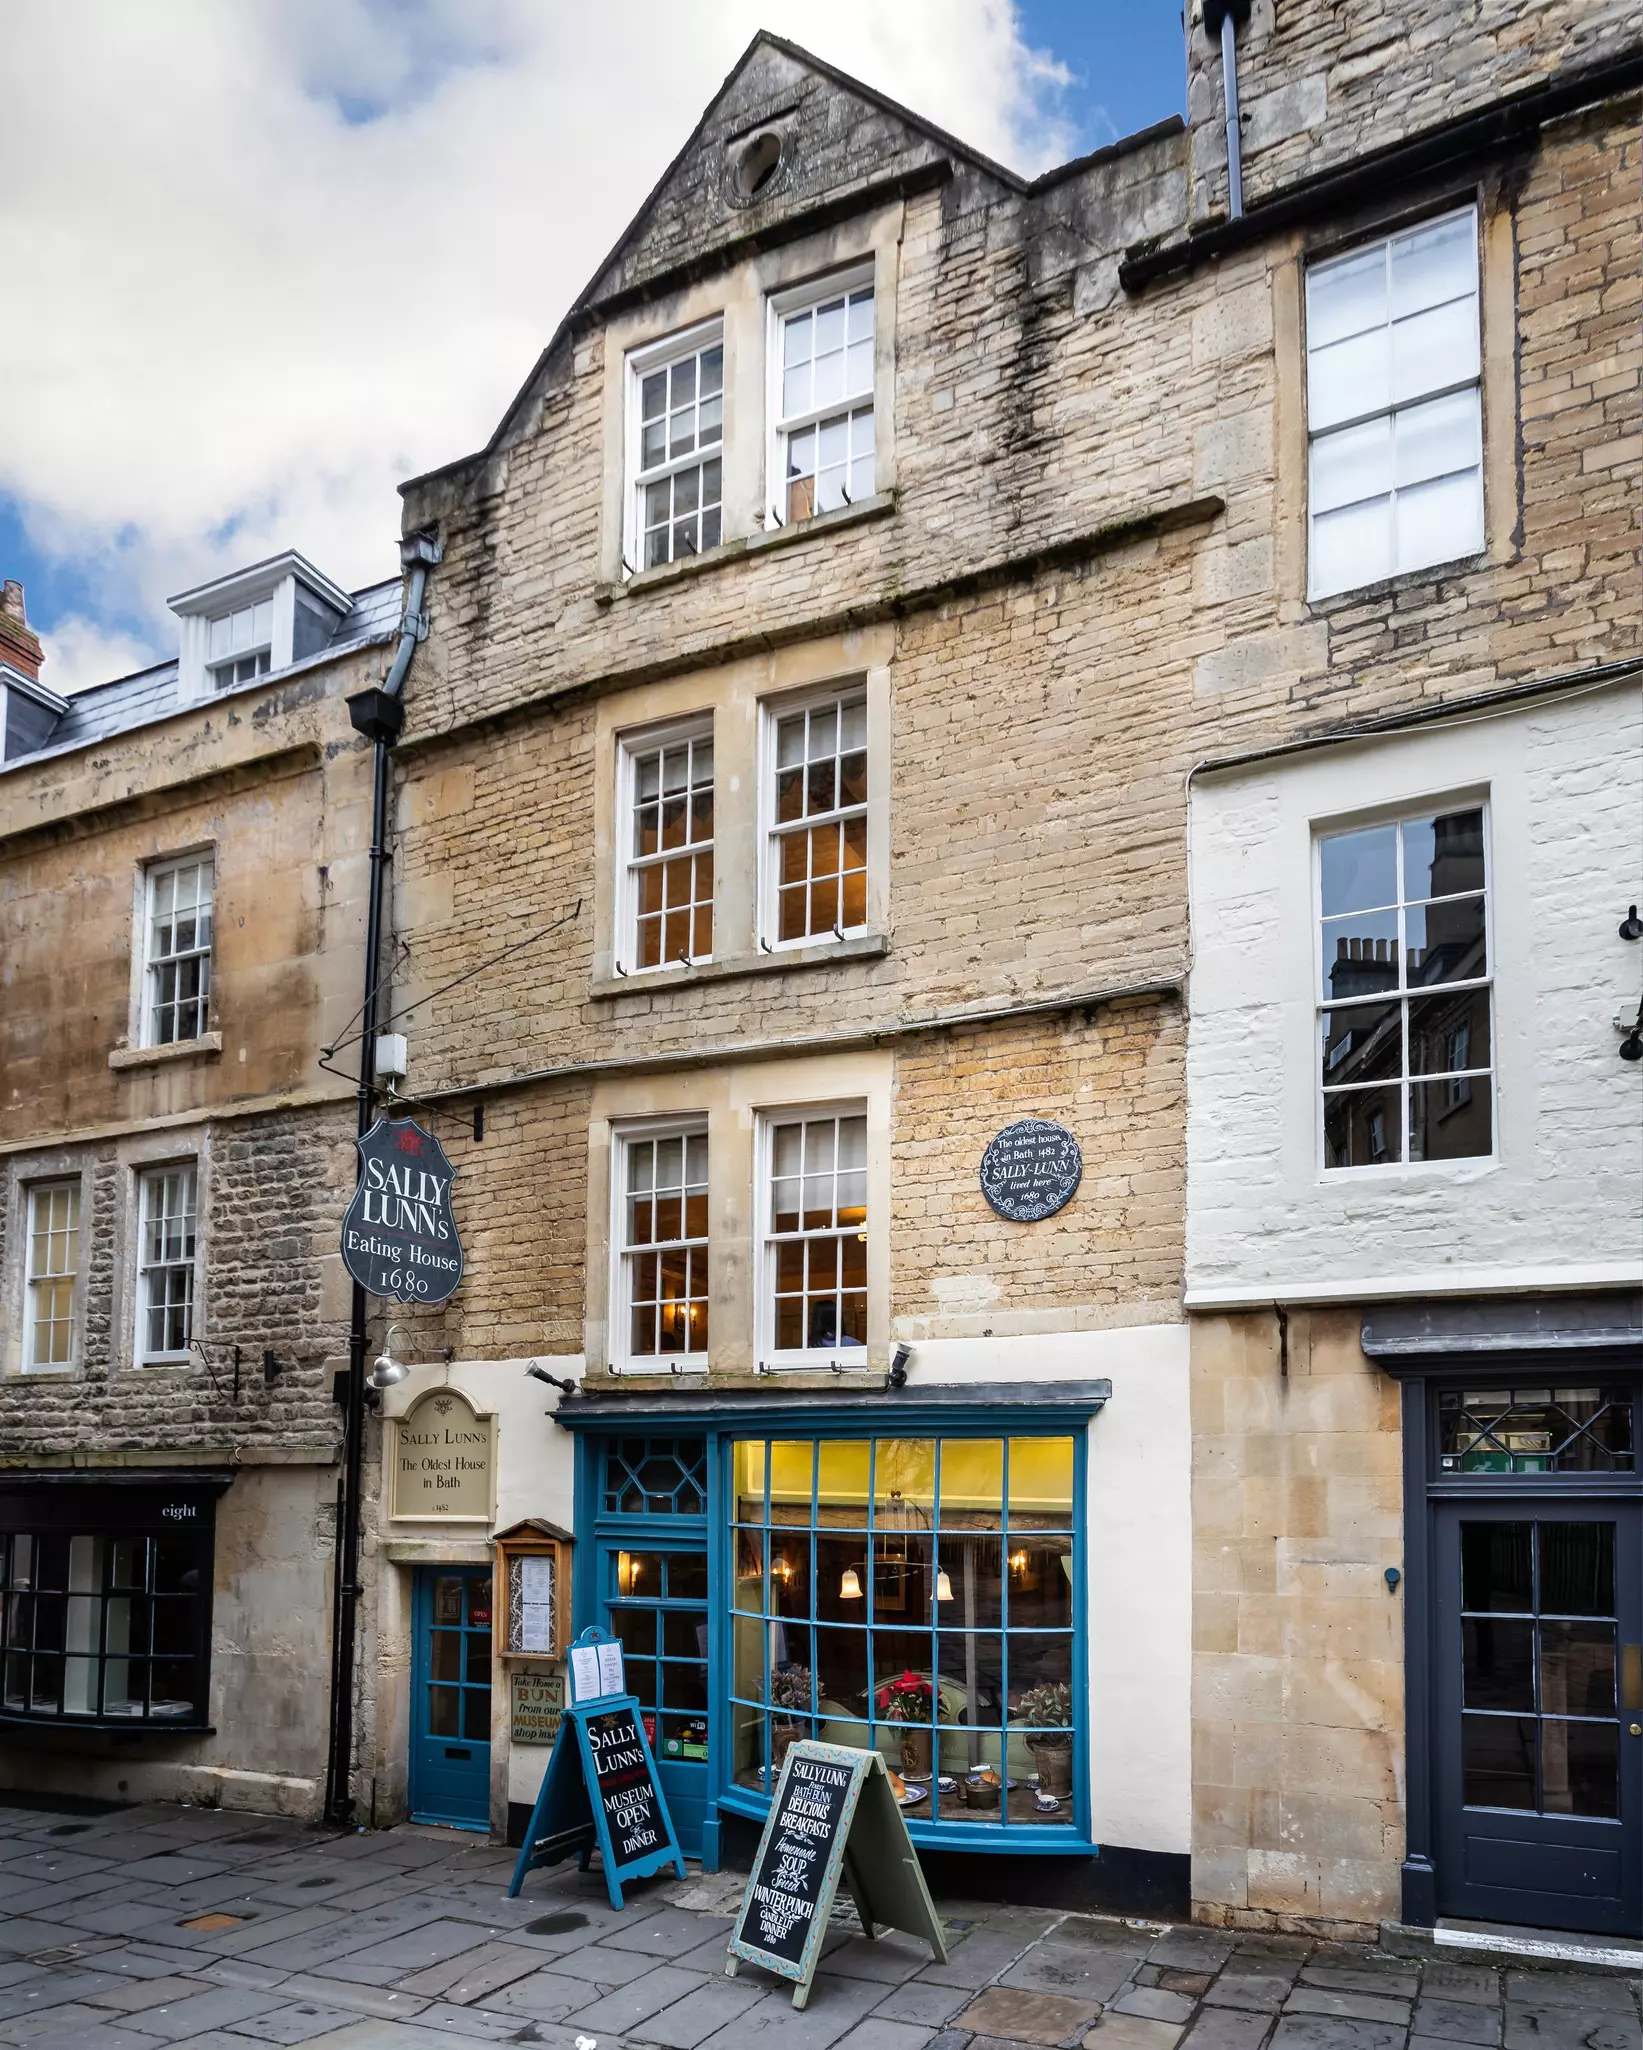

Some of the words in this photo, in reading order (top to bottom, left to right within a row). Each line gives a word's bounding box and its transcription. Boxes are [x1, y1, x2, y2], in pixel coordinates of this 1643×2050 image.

[998, 1140, 1012, 1148] The
[1015, 1137, 1036, 1146] oldest
[1039, 1135, 1061, 1143] house
[1014, 1149, 1033, 1160] Bath
[1039, 1147, 1055, 1158] 1482
[367, 1157, 448, 1206] SALLY
[1010, 1180, 1030, 1190] lived
[1033, 1179, 1052, 1187] here
[1021, 1191, 1040, 1201] 1680
[347, 1230, 402, 1263] Eating
[409, 1244, 458, 1272] House
[381, 1268, 428, 1294] 1680
[400, 1458, 417, 1471] The
[421, 1457, 451, 1471] Oldest
[455, 1457, 486, 1470] House
[423, 1477, 432, 1489] in
[436, 1474, 461, 1488] Bath
[162, 1504, 197, 1520] eight
[514, 1677, 530, 1686] Take
[533, 1678, 553, 1687] Home
[517, 1687, 559, 1703] BUN
[519, 1704, 541, 1714] from
[544, 1707, 561, 1715] our
[513, 1715, 562, 1728] MUSEUM
[514, 1728, 537, 1740] shop
[587, 1724, 637, 1751] SALLY
[603, 1783, 654, 1813] MUSEUM
[793, 1785, 813, 1799] BATH
[812, 1789, 832, 1803] BUNN
[616, 1802, 651, 1828] OPEN
[787, 1796, 831, 1820] DELICIOUS
[780, 1811, 831, 1839] BREAKFASTS
[622, 1829, 658, 1854] DINNER
[774, 1836, 817, 1861] Homemade
[780, 1854, 807, 1875] SOUP
[754, 1884, 788, 1911] WINTER
[785, 1895, 814, 1919] PUNCH
[760, 1920, 787, 1940] DINNER
[764, 1934, 777, 1945] 1680
